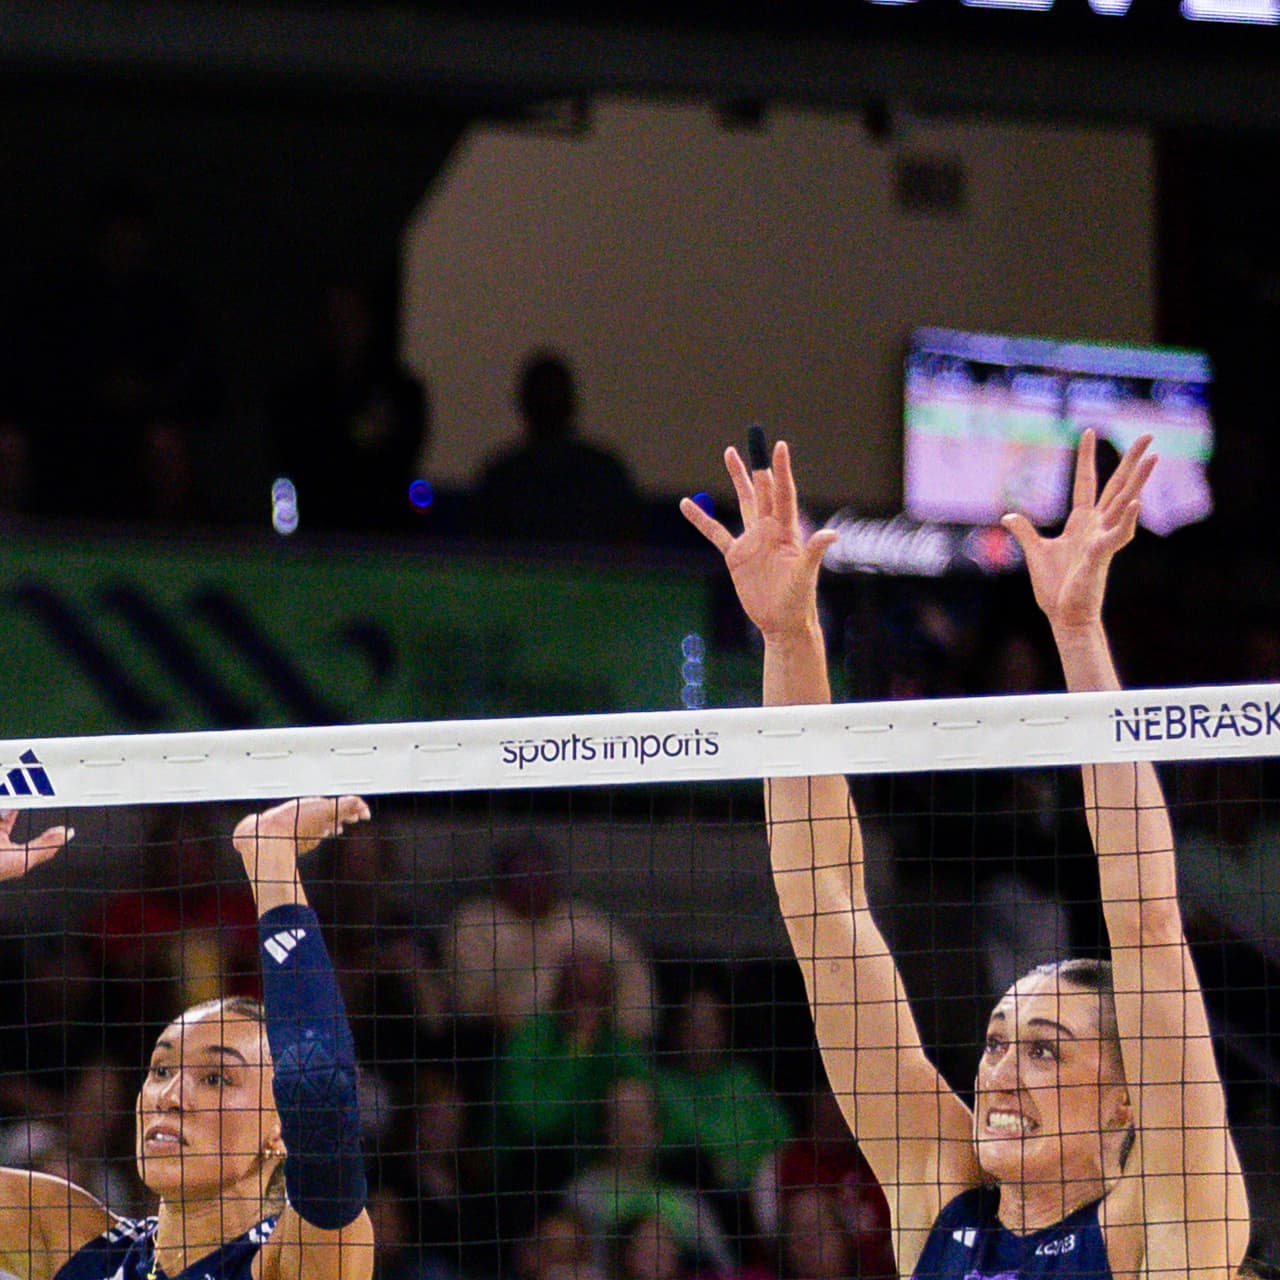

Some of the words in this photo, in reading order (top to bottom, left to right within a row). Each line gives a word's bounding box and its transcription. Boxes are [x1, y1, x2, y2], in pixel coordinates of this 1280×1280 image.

[1114, 701, 1280, 743] NEBRASK
[499, 733, 597, 770] sports
[601, 728, 721, 765] imports
